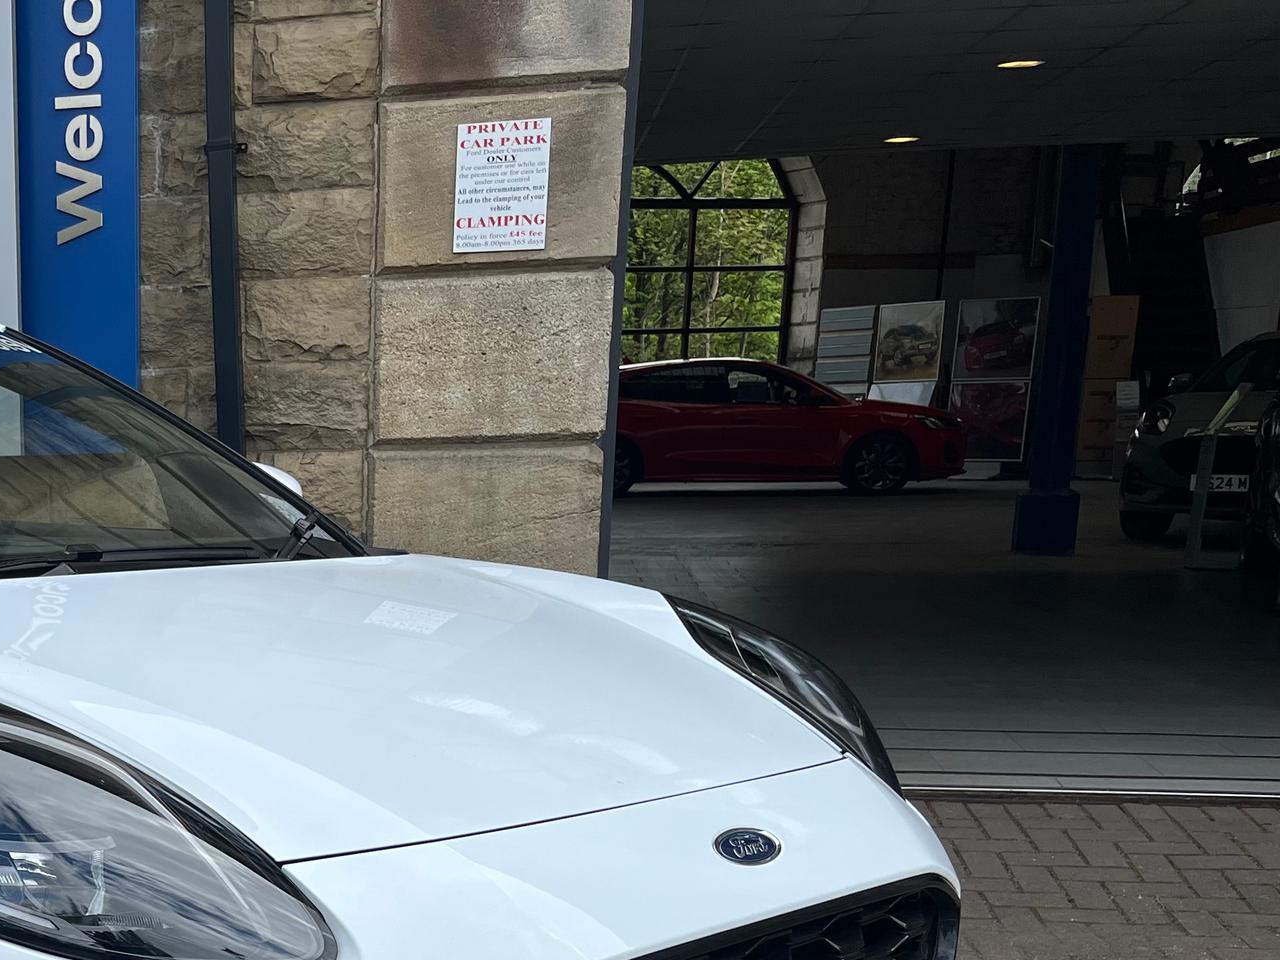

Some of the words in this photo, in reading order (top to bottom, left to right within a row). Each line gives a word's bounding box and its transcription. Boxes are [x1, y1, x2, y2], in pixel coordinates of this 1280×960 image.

[467, 120, 543, 134] PRIVATE
[460, 138, 494, 149] CAR
[500, 134, 548, 146] PARK
[466, 149, 482, 157] Ford
[483, 147, 505, 155] Dealer
[506, 146, 542, 154] Customers
[486, 154, 517, 163] ONLY
[473, 163, 504, 171] customer
[517, 160, 536, 168] while
[470, 171, 500, 180] premises
[506, 176, 531, 184] control
[457, 188, 467, 196] All
[468, 187, 484, 195] other
[485, 185, 531, 194] circumstances,
[532, 184, 546, 192] may
[457, 197, 473, 205] Lead
[481, 195, 493, 203] the
[493, 194, 521, 204] clamping
[522, 193, 530, 201] of
[530, 193, 545, 202] your
[456, 213, 545, 229] CLAMPING
[456, 233, 478, 242] Policy
[489, 231, 508, 239] force
[509, 230, 526, 238] £45
[528, 229, 543, 237] fee
[527, 238, 544, 246] days
[724, 831, 772, 860] Ford
